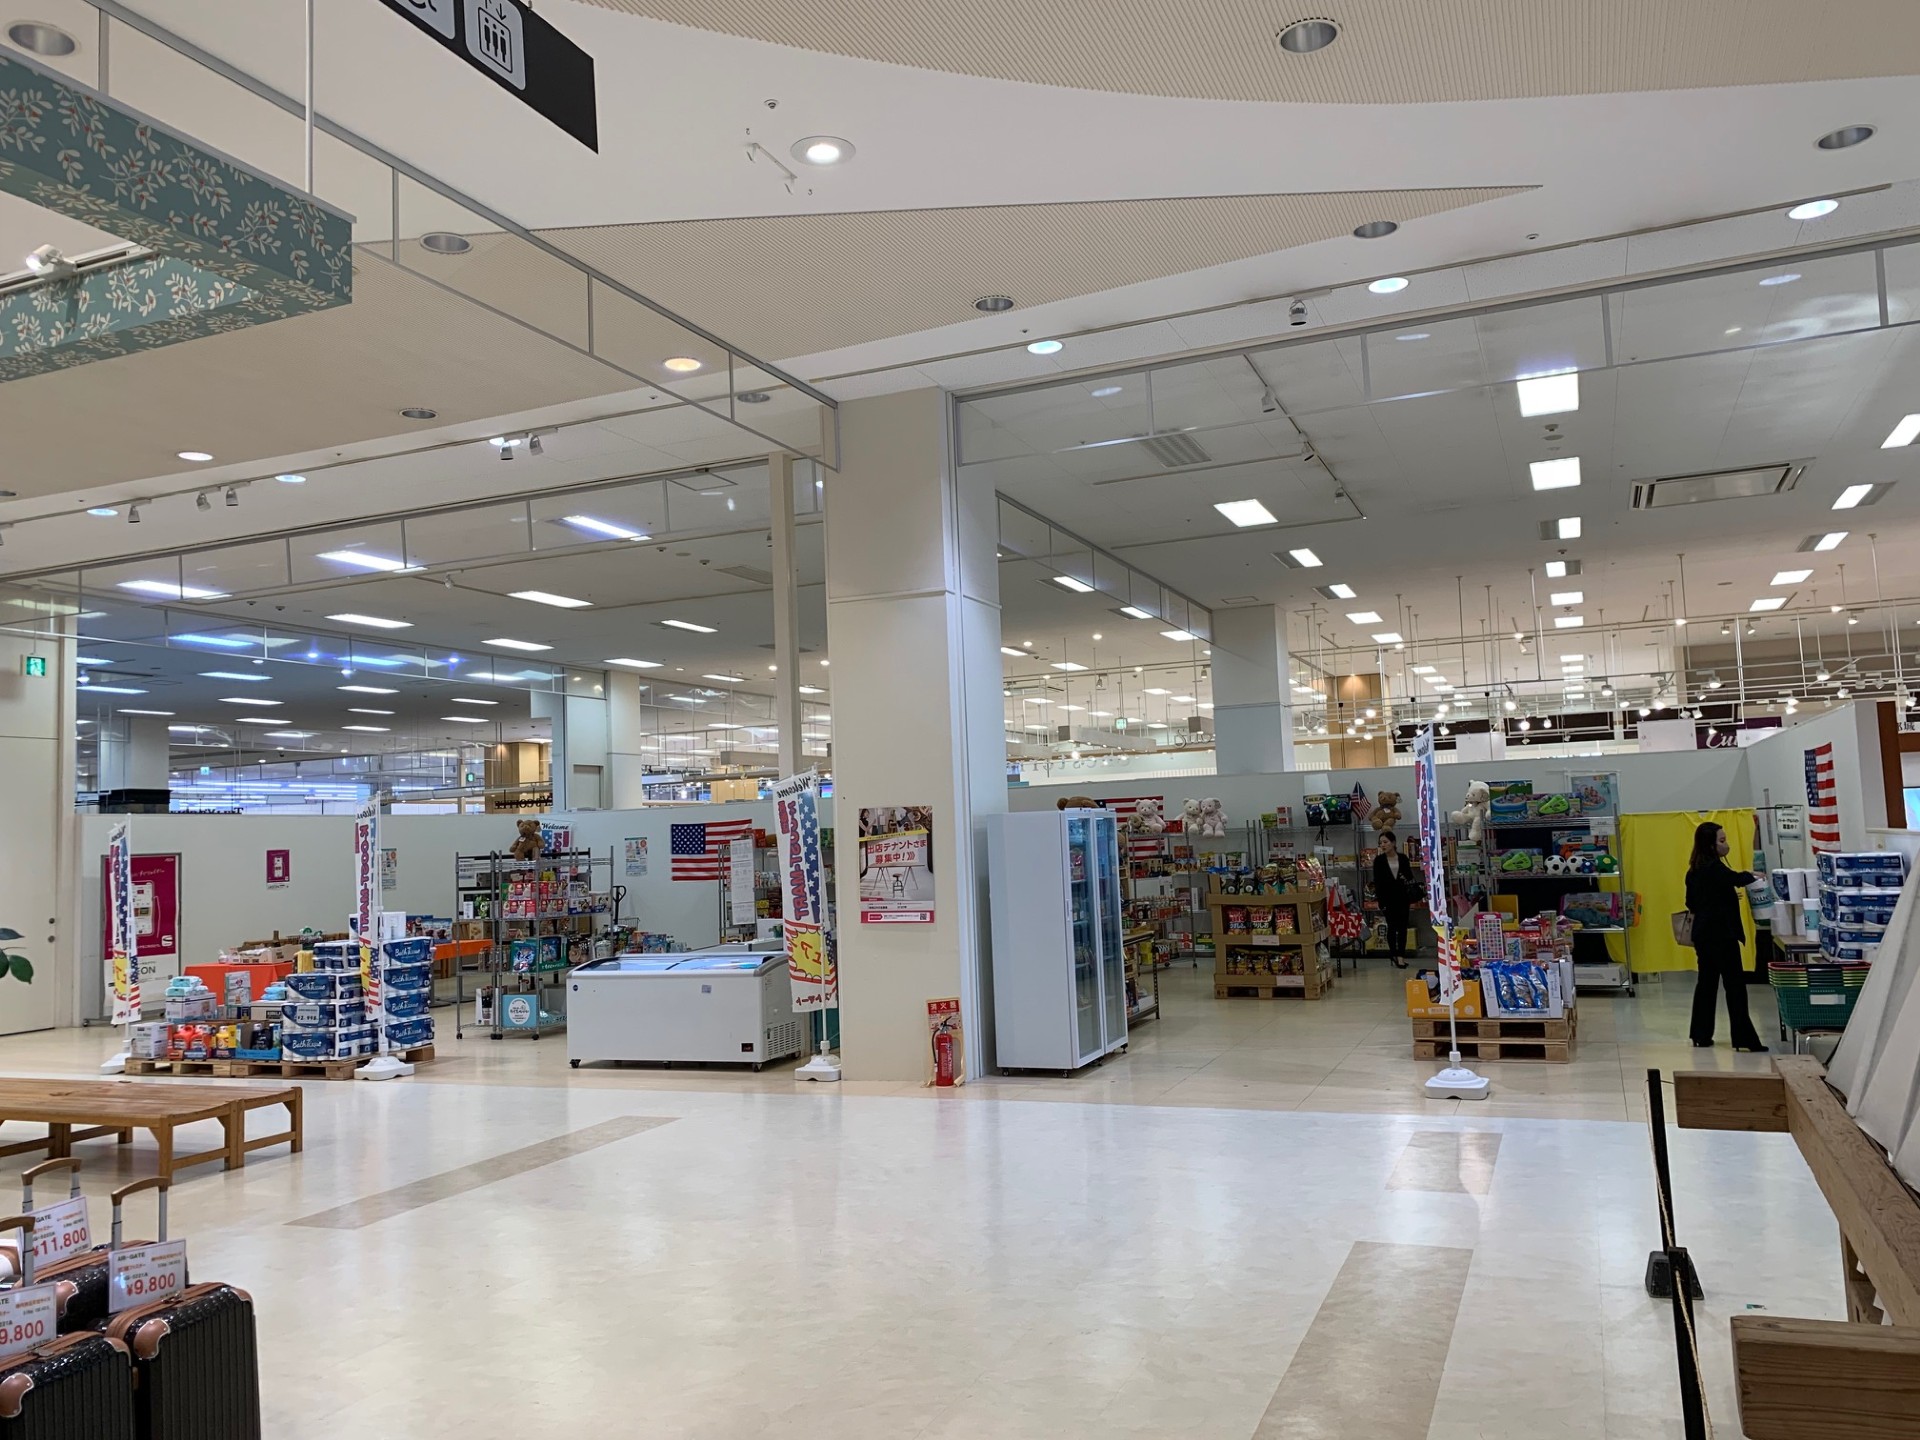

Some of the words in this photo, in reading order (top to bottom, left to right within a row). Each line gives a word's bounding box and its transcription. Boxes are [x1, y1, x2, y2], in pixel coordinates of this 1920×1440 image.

[541, 822, 569, 830] Welcome
[867, 839, 927, 854] 出店テナントさま
[395, 947, 407, 957] Bath
[140, 966, 156, 975] ON
[298, 982, 311, 991] Bath
[930, 1001, 957, 1011] 消火器
[292, 1039, 306, 1048] Bath
[36, 1214, 51, 1223] GATE
[117, 1252, 145, 1262] AIR-GATE
[127, 1272, 176, 1296] ¥9,800
[0, 1319, 44, 1345] 9,800
